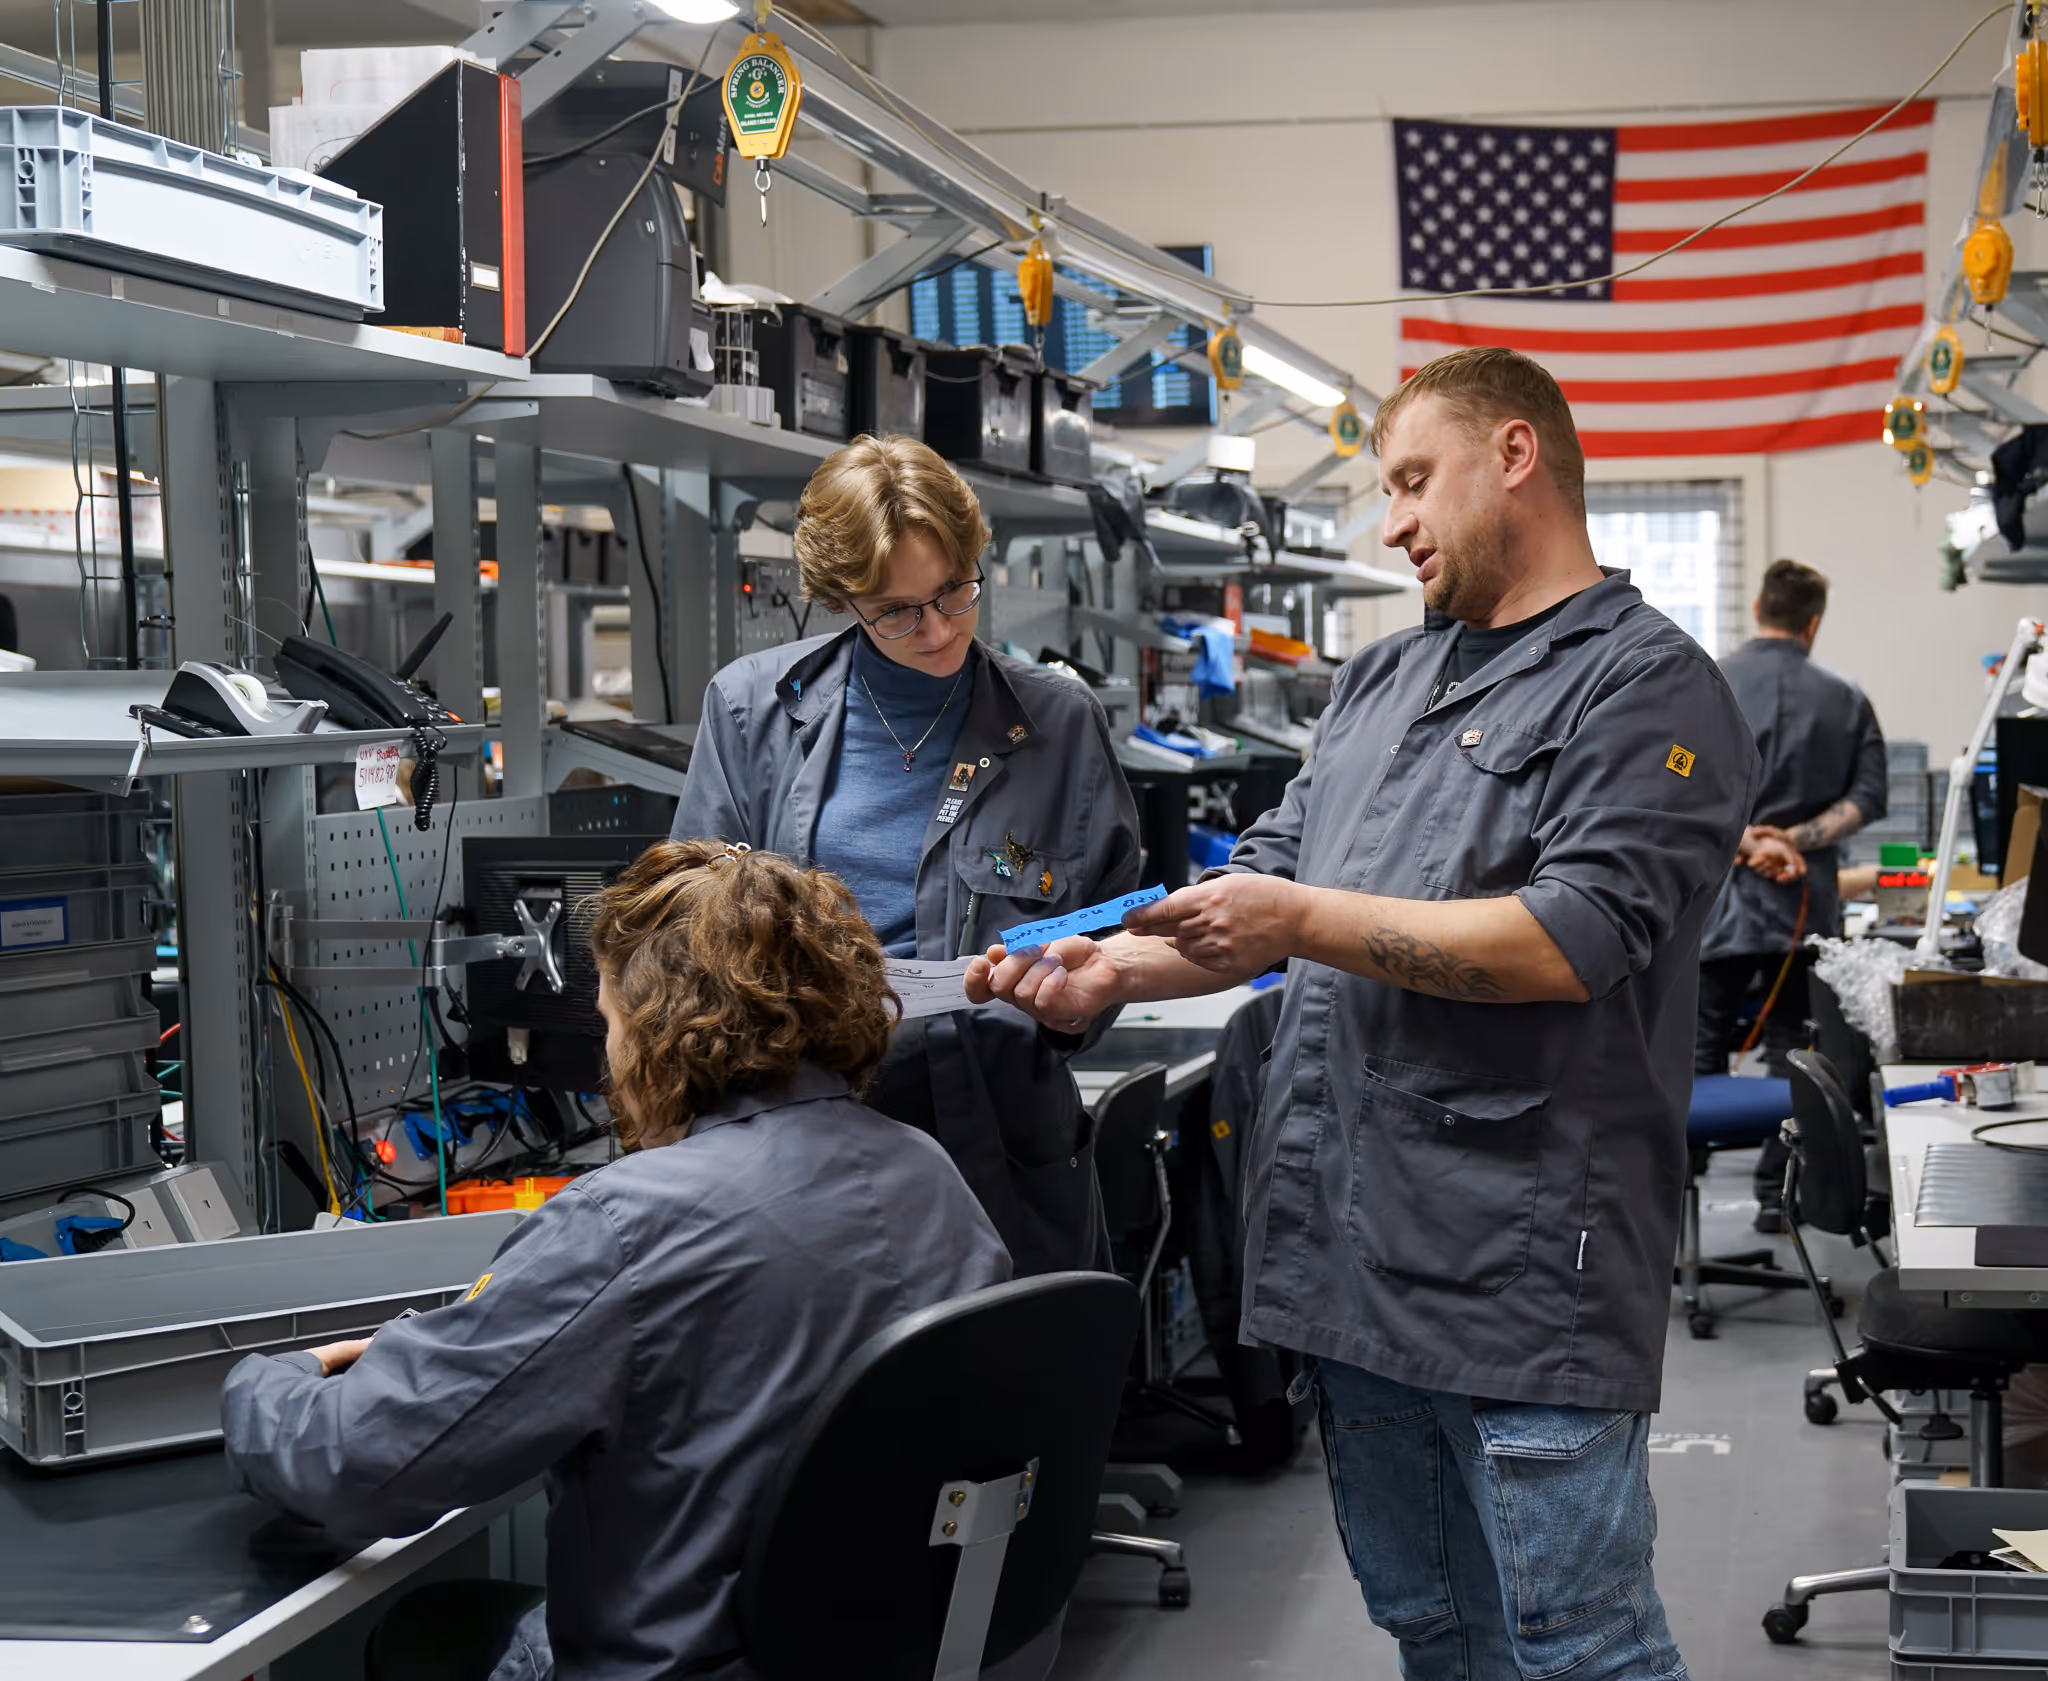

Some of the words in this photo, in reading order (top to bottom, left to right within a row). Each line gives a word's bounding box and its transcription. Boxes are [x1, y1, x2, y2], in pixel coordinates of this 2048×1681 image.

[730, 62, 750, 98] SPRING
[751, 58, 785, 94] BALANCER
[945, 797, 964, 806] PLEASE
[938, 808, 949, 816] PET
[949, 804, 961, 812] NOT
[935, 815, 956, 824] PEEVES
